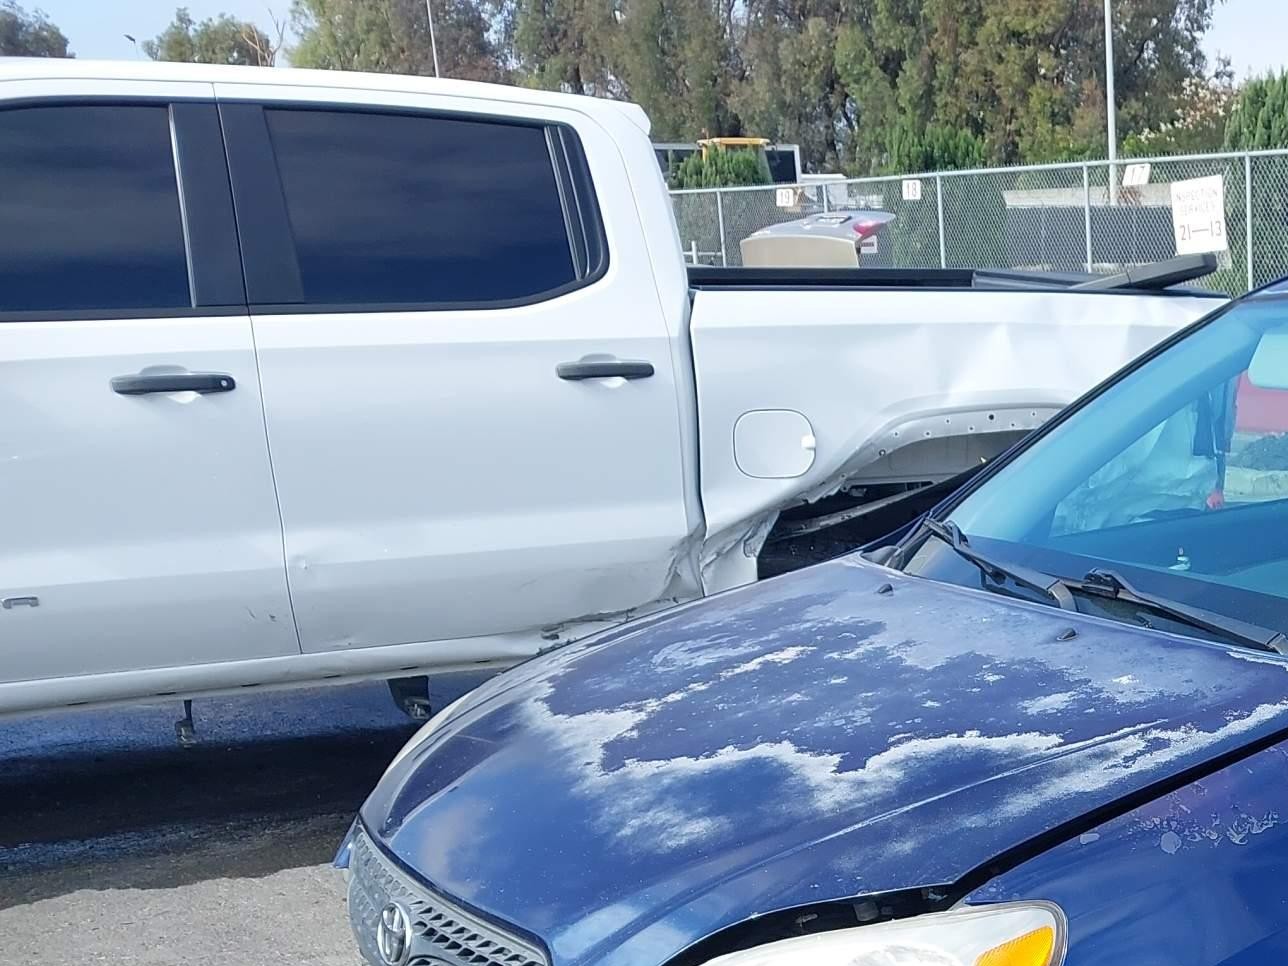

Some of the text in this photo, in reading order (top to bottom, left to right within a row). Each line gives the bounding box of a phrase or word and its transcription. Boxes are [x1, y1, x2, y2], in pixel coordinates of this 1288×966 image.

[1130, 166, 1145, 184] 17
[780, 190, 790, 204] 19
[906, 181, 917, 198] 18
